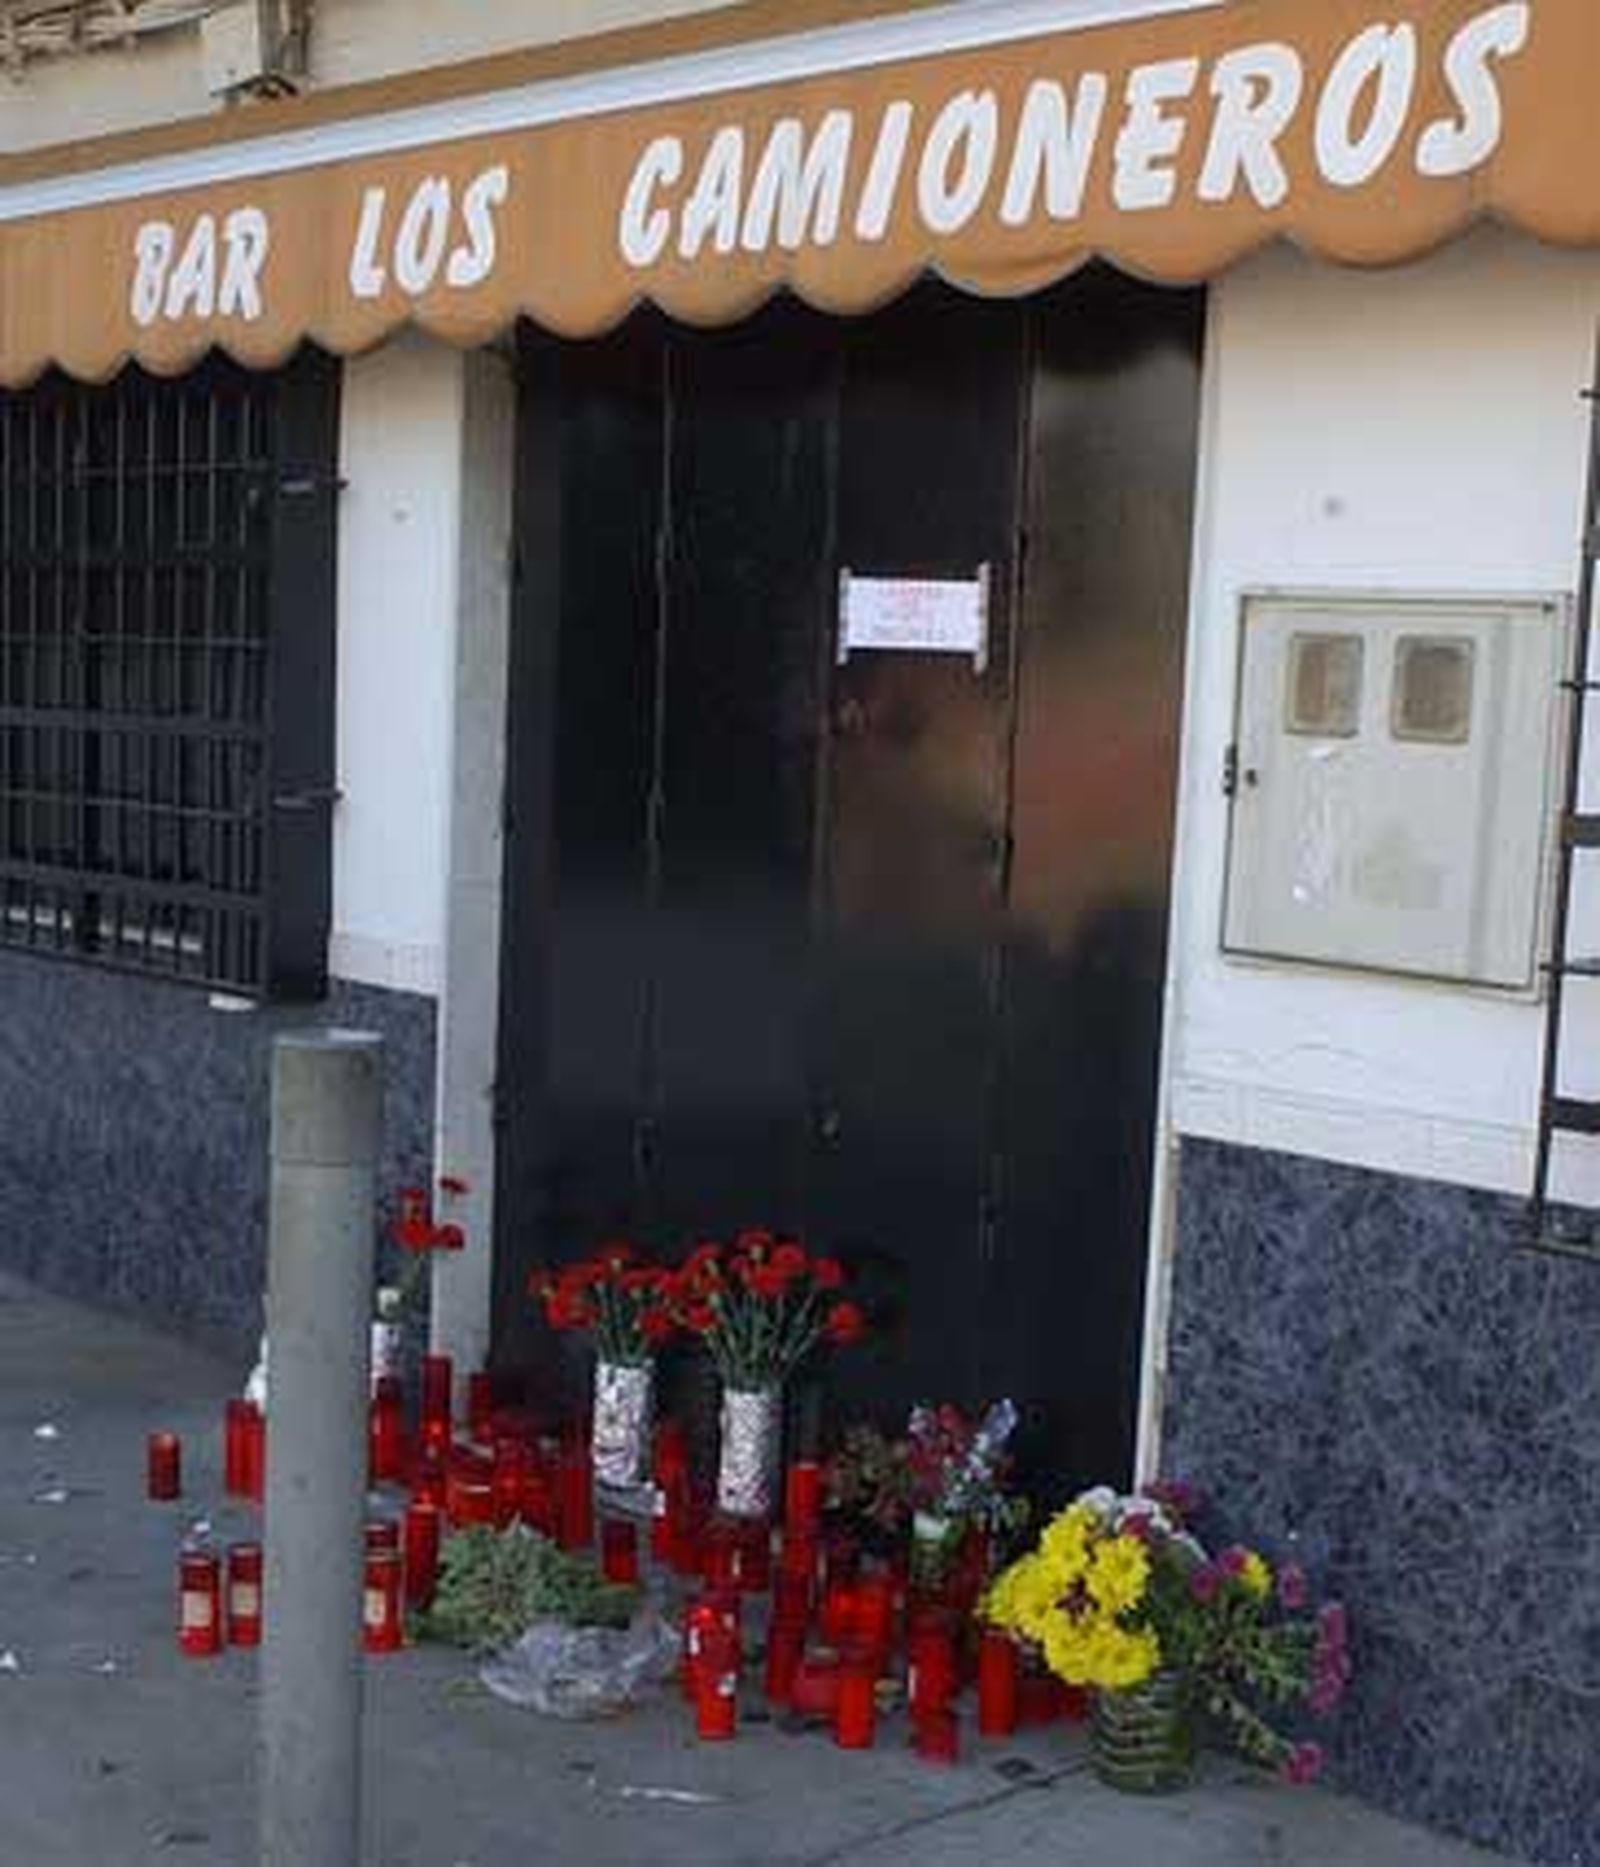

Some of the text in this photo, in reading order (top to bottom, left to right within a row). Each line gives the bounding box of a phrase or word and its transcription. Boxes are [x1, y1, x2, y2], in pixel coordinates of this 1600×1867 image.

[129, 1, 1529, 327] BAR LOS CAMIONEROS
